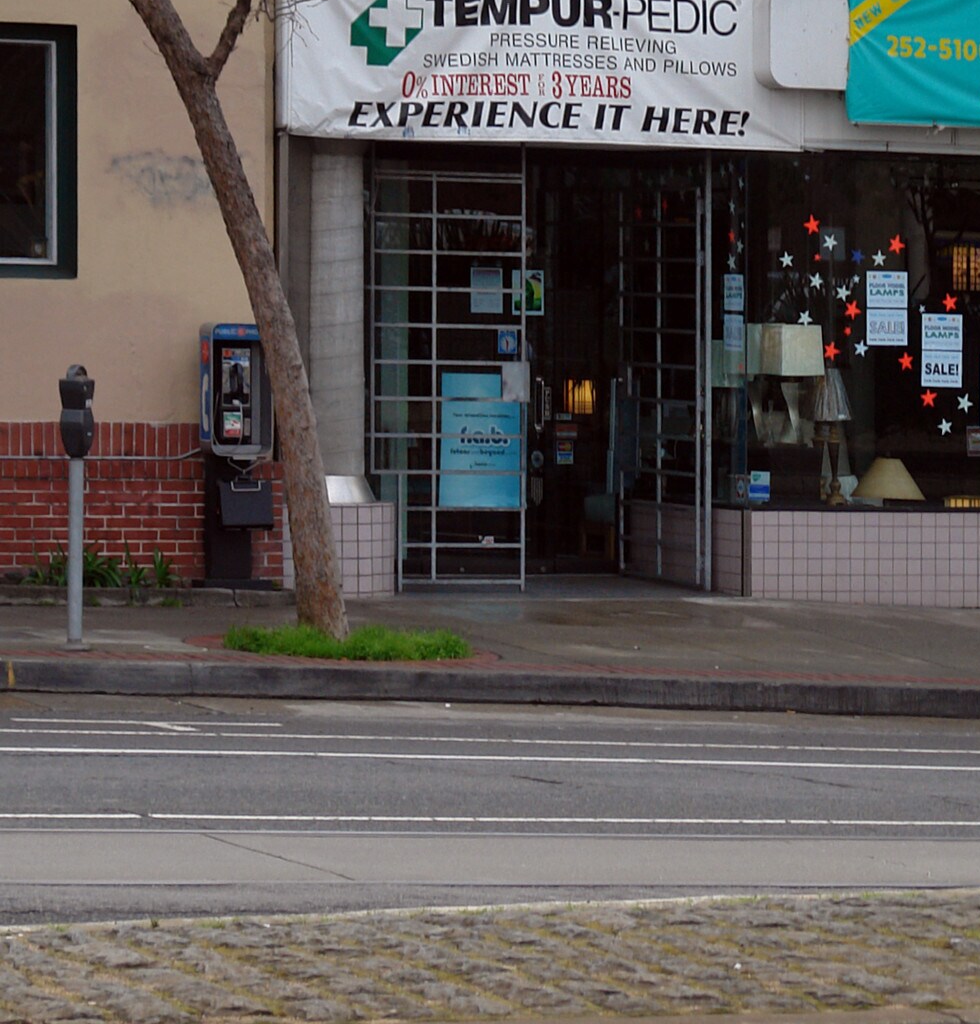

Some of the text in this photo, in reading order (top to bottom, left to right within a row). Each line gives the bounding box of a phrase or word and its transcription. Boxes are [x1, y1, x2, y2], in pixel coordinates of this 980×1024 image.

[853, 1, 883, 30] NEW
[490, 33, 677, 54] PRESSURE RELIEVING
[423, 52, 737, 77] SWEDISH MATTRESSES AND PILLOWS
[402, 70, 429, 99] 0%
[431, 72, 531, 97] INTEREST
[552, 70, 563, 99] 3
[565, 73, 632, 99] YEARS
[348, 100, 750, 137] EXPERIENCE IT HERE!
[869, 289, 905, 297] LAMPS
[924, 331, 960, 339] LAMPS
[924, 363, 959, 376] SALE!
